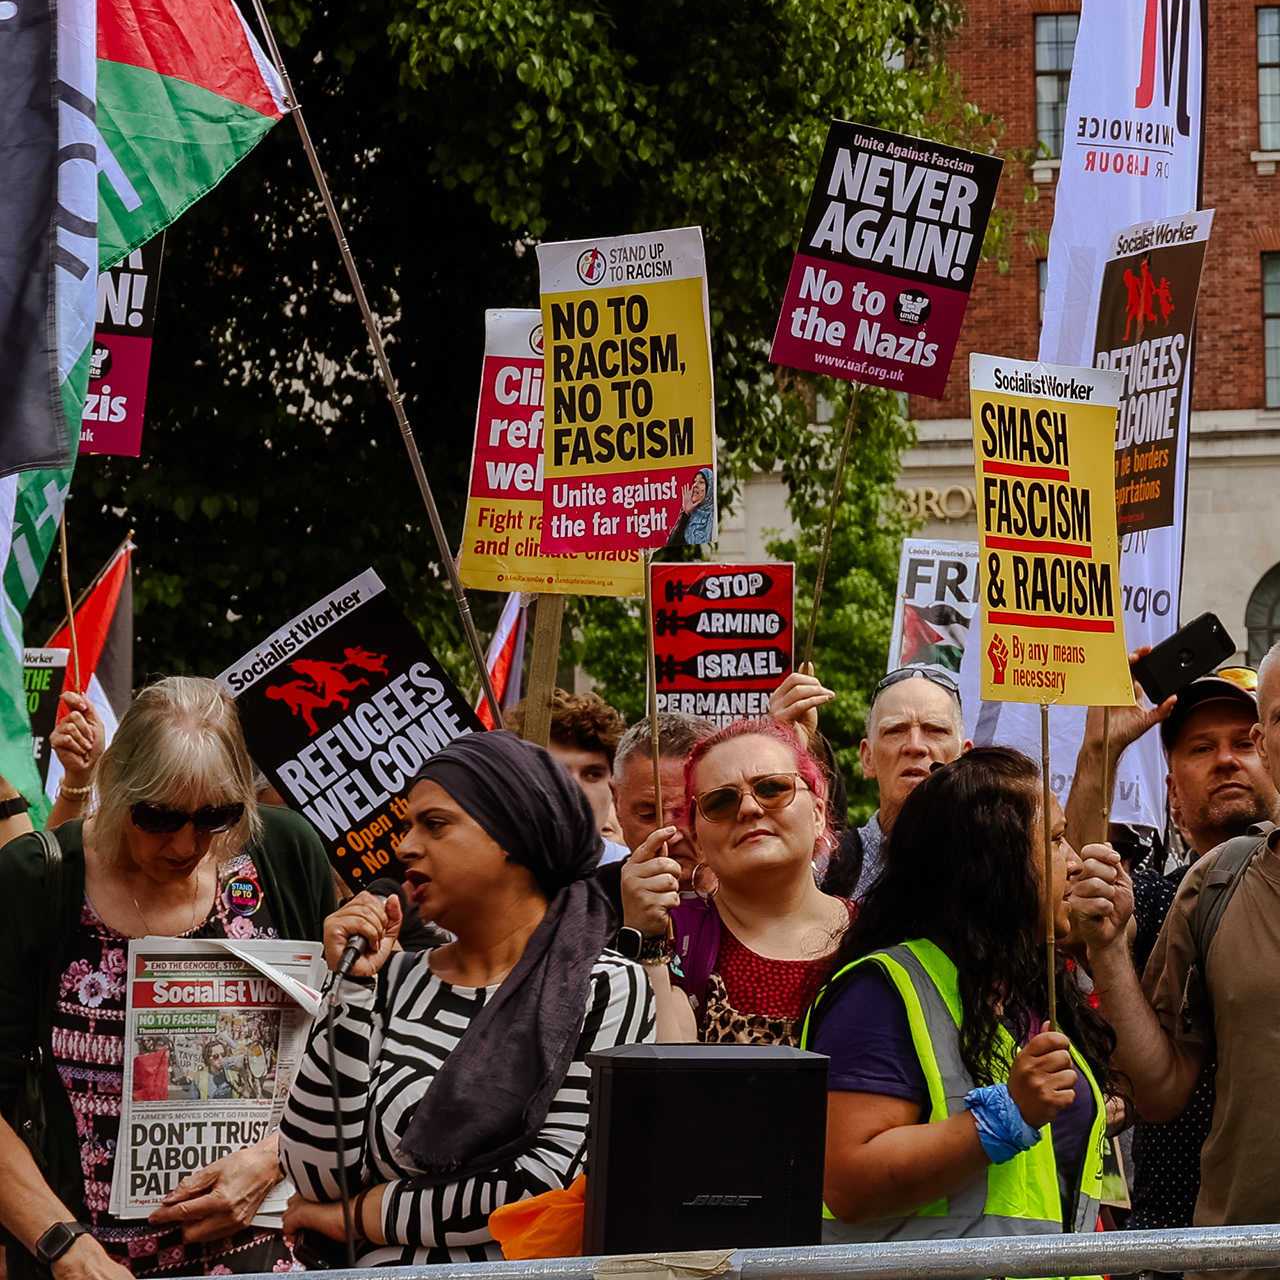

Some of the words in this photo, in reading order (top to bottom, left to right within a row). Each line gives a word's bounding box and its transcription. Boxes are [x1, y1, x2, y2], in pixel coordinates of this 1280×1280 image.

[853, 134, 885, 153] Unite
[886, 142, 929, 162] Against
[931, 152, 975, 174] Fascism
[827, 147, 979, 228] NEVER
[609, 245, 647, 264] STAND
[648, 243, 665, 260] UP
[809, 201, 974, 281] AGAIN!
[610, 266, 625, 282] TO
[626, 259, 673, 280] RACISM
[799, 265, 844, 305] No
[852, 281, 886, 316] to
[551, 299, 600, 341] NO
[607, 293, 649, 335] TO
[791, 306, 846, 346] the
[853, 319, 939, 367] Nazis
[553, 333, 687, 383] RACISM,
[814, 352, 905, 382] www.uaf.org.uk
[553, 383, 602, 425] NO
[611, 378, 653, 419] TO
[553, 416, 694, 467] FASCISM
[981, 401, 1069, 466] SMASH
[1133, 444, 1169, 473] borders
[552, 482, 607, 509] Unite
[612, 476, 678, 509] against
[1115, 476, 1161, 512] eportations
[477, 507, 523, 533] Fight
[551, 514, 585, 538] the
[592, 511, 621, 536] far
[626, 507, 668, 538] right
[984, 477, 1092, 542] FASCISM
[473, 536, 509, 556] and
[908, 545, 930, 556] Leeds
[931, 549, 963, 558] Palestine
[705, 573, 763, 599] STOP
[987, 551, 1006, 608] &
[1013, 555, 1114, 617] RACISM
[696, 612, 780, 634] ARMING
[697, 651, 783, 678] ISRAEL
[1012, 635, 1026, 660] By
[1028, 640, 1049, 666] any
[1053, 642, 1085, 664] means
[1013, 667, 1067, 694] necessary
[656, 692, 771, 714] PERMANEN
[276, 661, 445, 805] REFUGEES
[302, 698, 474, 841] WELCOME
[346, 814, 393, 852] Open
[360, 849, 390, 874] No
[231, 882, 253, 891] STAND
[151, 961, 167, 970] END
[169, 961, 183, 970] THE
[223, 961, 242, 970] STOP
[152, 979, 246, 1003] Socialist
[139, 1014, 155, 1025] NO
[157, 1014, 171, 1025] TO
[172, 1013, 217, 1025] FASCISM
[131, 1122, 208, 1147] DON'T
[211, 1121, 269, 1144] TRUST
